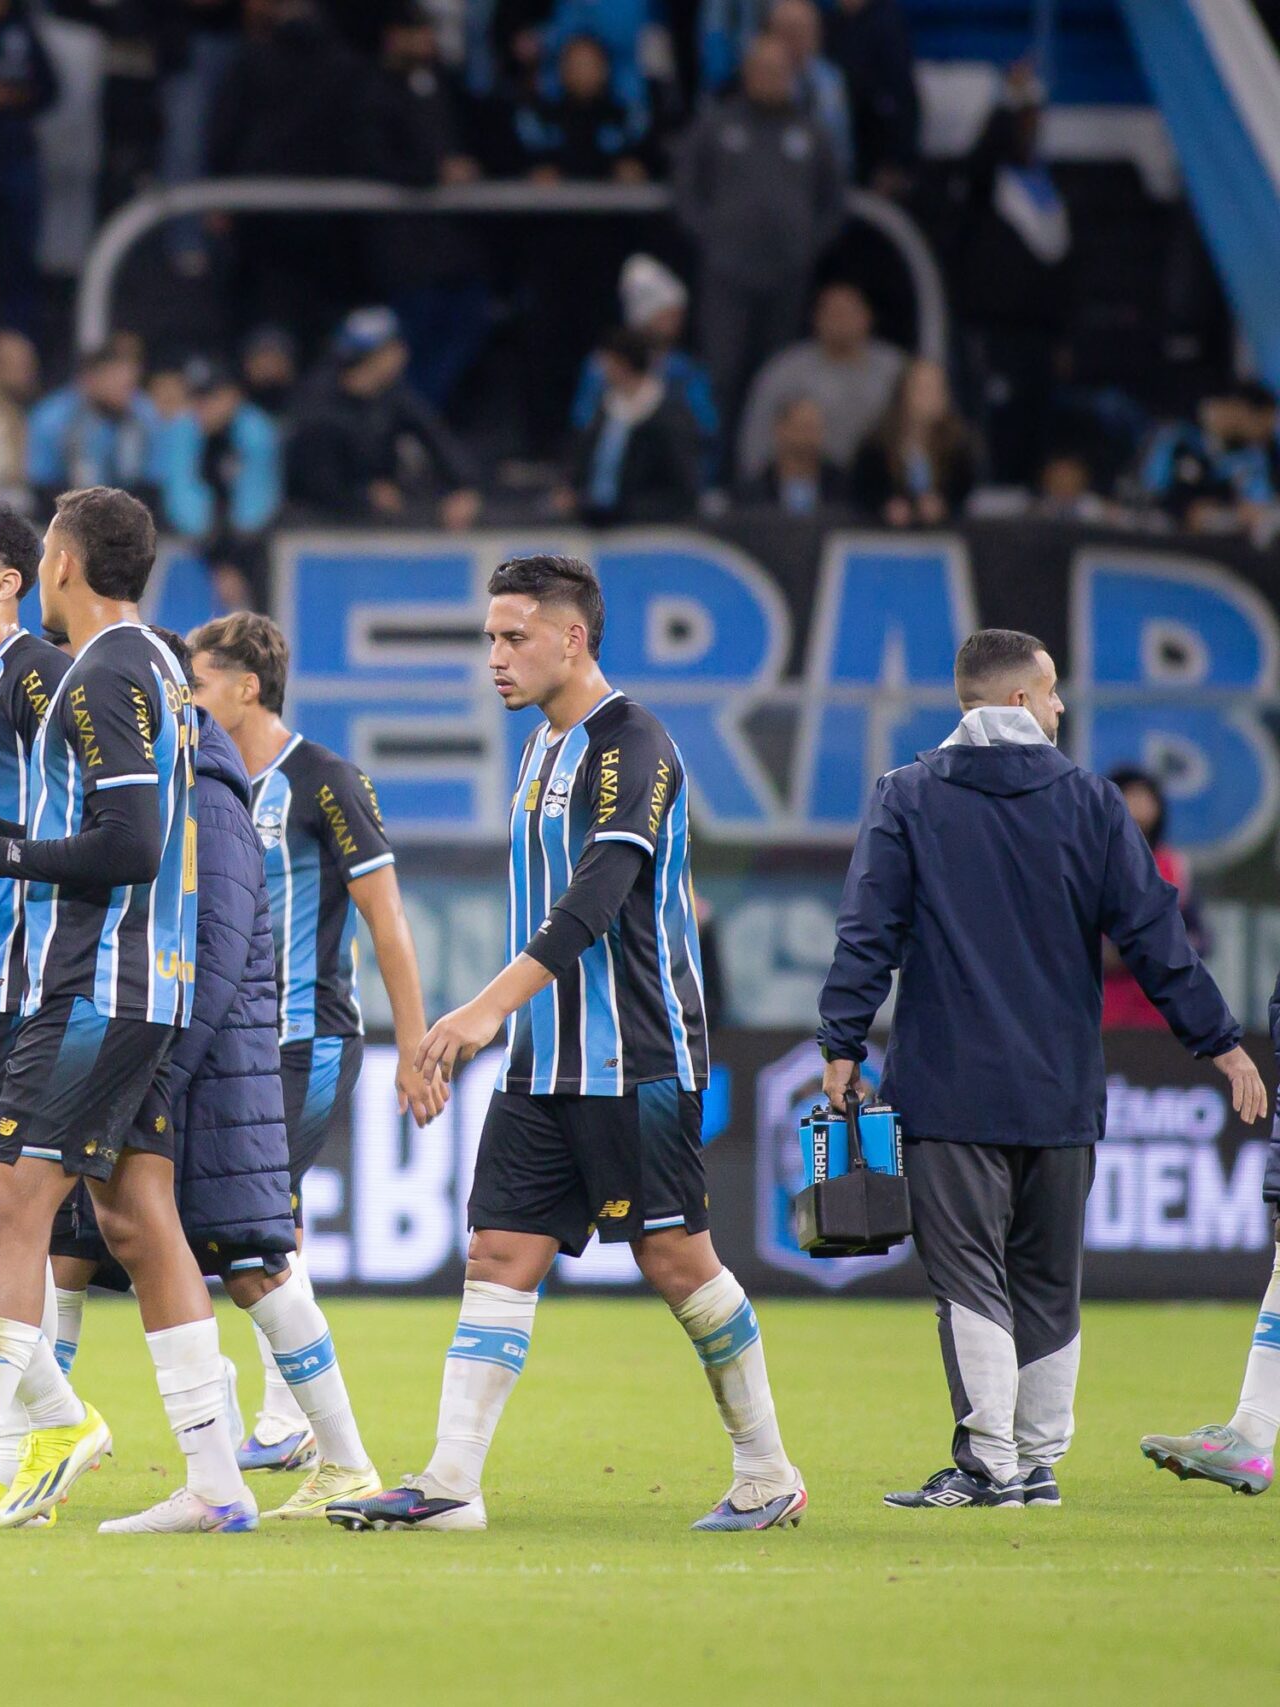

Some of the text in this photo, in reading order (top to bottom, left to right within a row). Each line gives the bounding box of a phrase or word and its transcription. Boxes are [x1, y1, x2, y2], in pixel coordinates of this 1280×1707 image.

[70, 685, 103, 768] HAVAN
[315, 784, 358, 855] HAVAN
[598, 748, 620, 824] HAVAN
[648, 758, 670, 836] HAVAN
